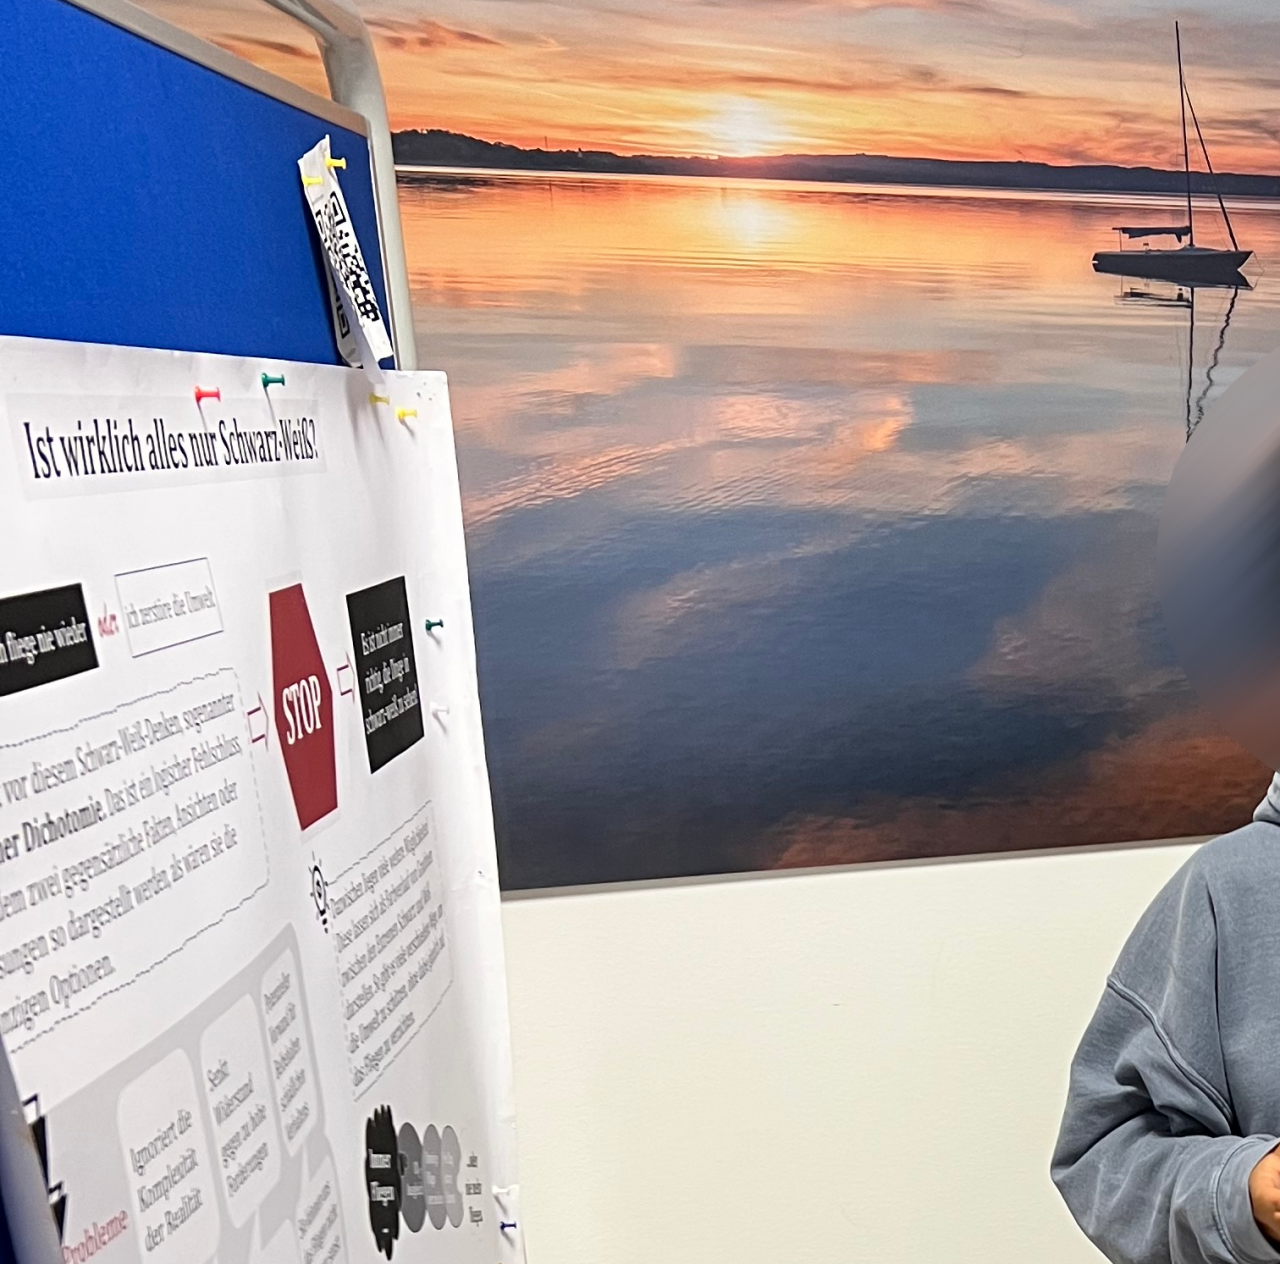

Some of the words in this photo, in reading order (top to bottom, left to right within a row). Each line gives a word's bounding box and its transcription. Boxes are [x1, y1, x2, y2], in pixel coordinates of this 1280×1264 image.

[23, 421, 61, 478] Ist
[60, 419, 145, 476] wirklich
[146, 418, 188, 470] alles
[188, 430, 218, 467] nur
[219, 417, 318, 466] Schwarz-Weiß?
[54, 616, 87, 648] wieder
[282, 674, 322, 745] STOP
[22, 795, 107, 852] Dichotomie.
[145, 1223, 165, 1252] der
